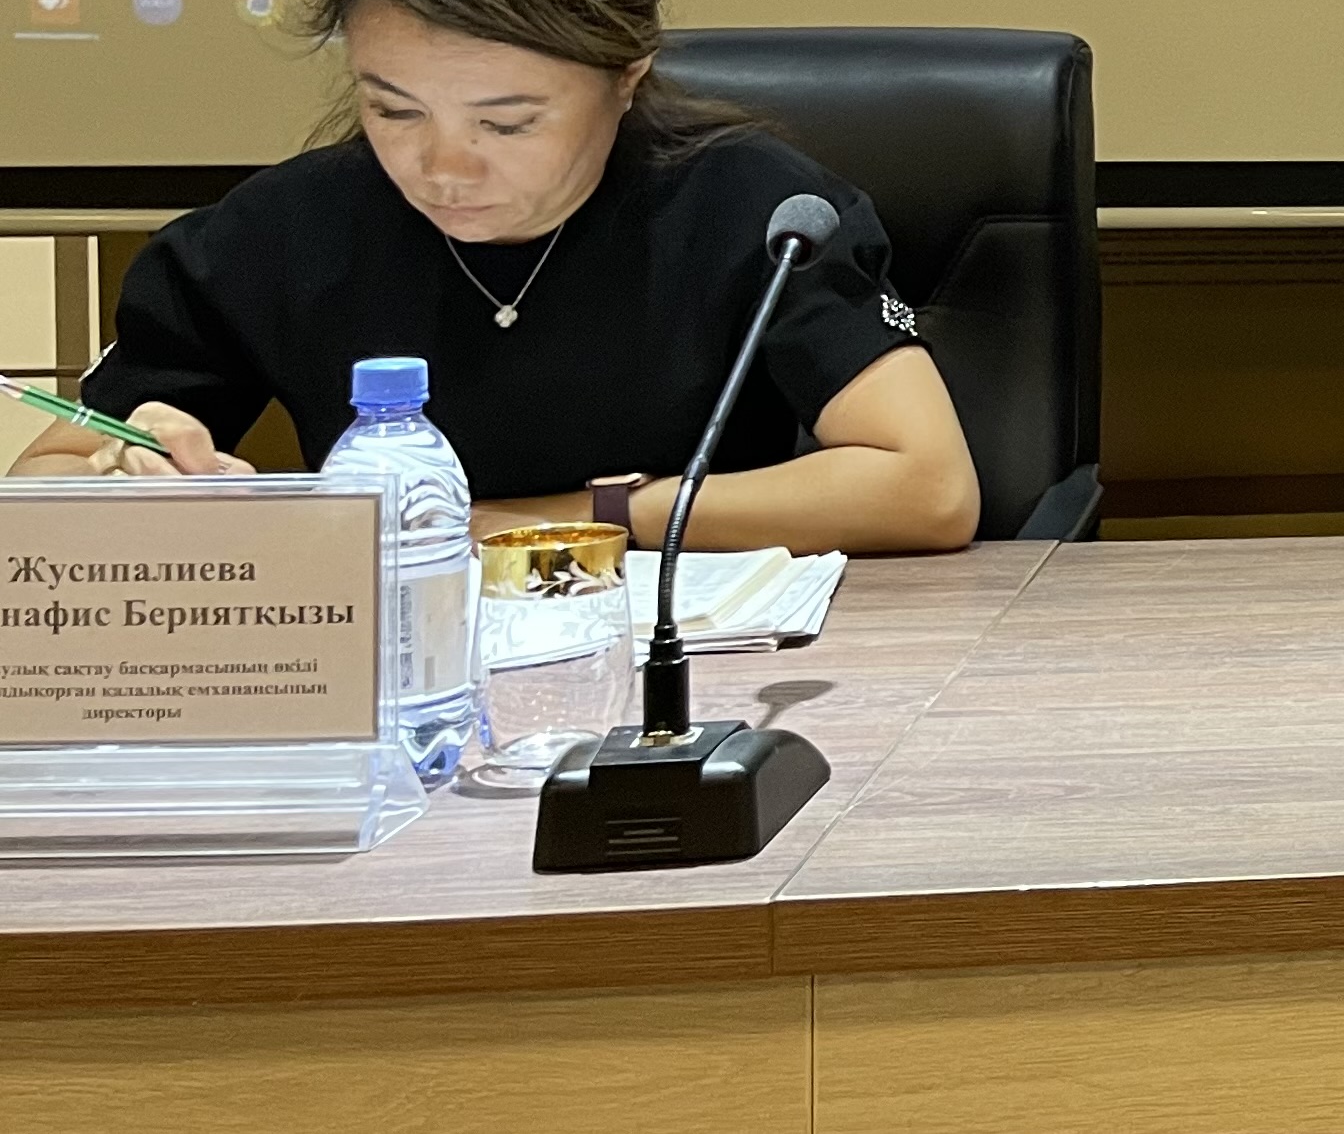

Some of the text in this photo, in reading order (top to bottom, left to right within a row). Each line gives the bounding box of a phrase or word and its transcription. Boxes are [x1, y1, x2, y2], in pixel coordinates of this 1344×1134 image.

[8, 556, 257, 590] Жусипалиева
[1, 599, 355, 635] нафис Бериятқызы
